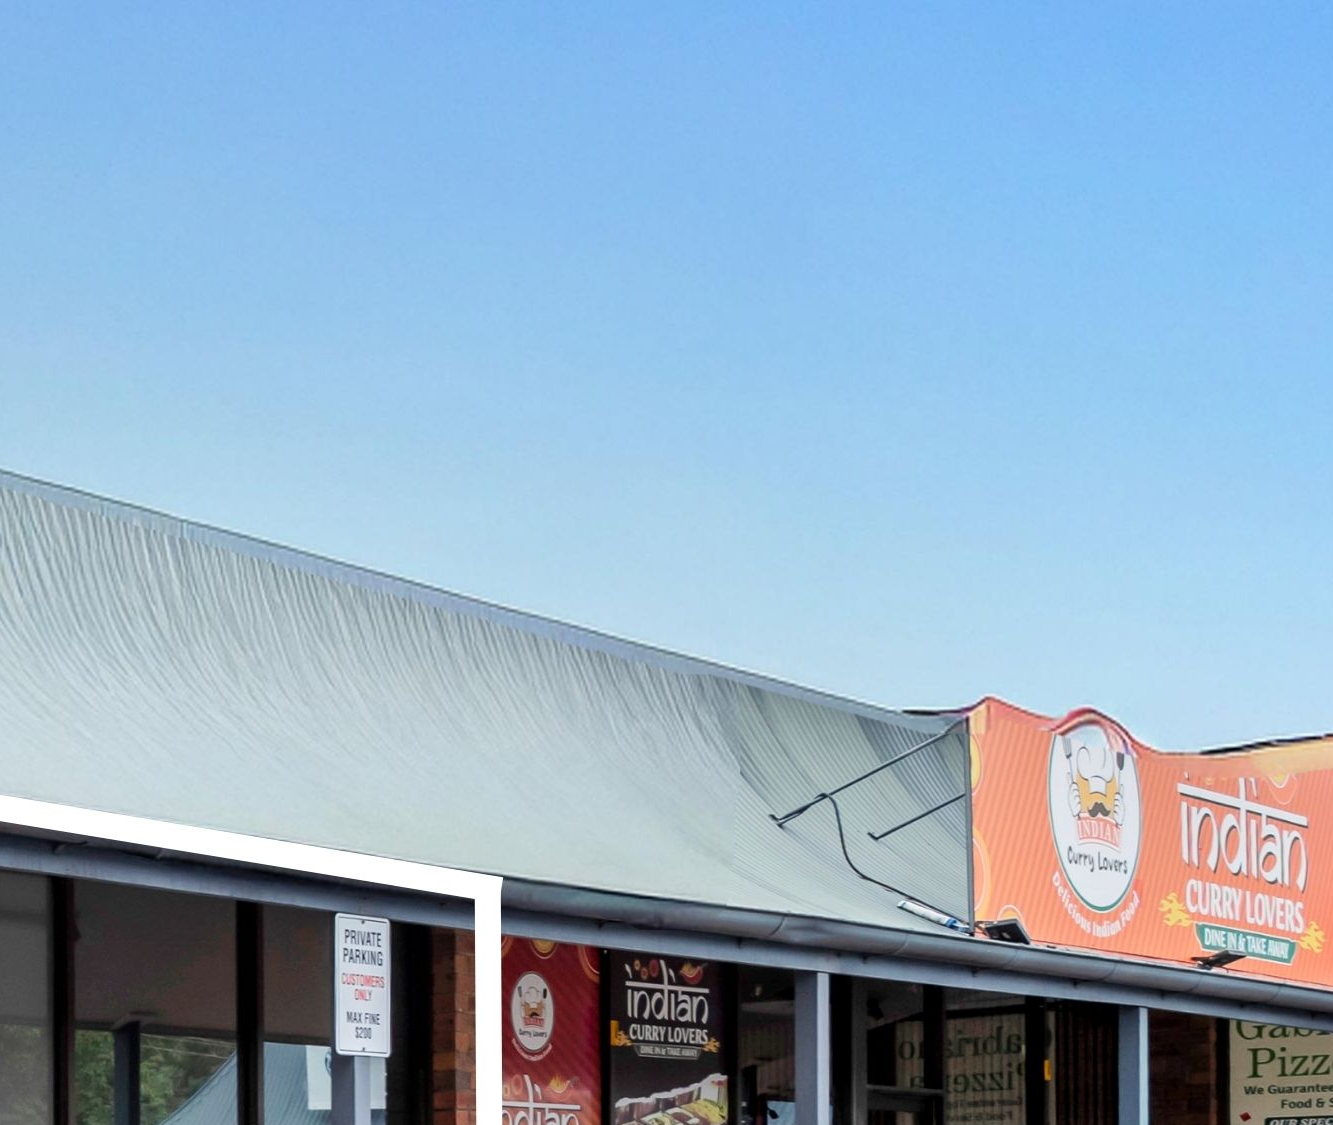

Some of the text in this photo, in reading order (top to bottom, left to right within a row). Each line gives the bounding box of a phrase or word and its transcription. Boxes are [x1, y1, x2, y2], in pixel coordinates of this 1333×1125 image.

[1077, 818, 1124, 848] INDIAN
[1177, 772, 1309, 893] indian
[1067, 846, 1128, 874] Curry Lovers
[1052, 872, 1091, 934] Delicious
[1092, 915, 1121, 937] Indian
[1186, 879, 1305, 934] CURRY LOVERS
[344, 929, 382, 948] PRIVATE
[1204, 927, 1226, 947] DINE
[1227, 930, 1238, 948] IN
[1246, 934, 1267, 955] TAKE
[1267, 939, 1290, 960] AWAY
[343, 947, 383, 966] PARKING
[341, 973, 385, 988] CUSTOMERS
[354, 988, 372, 1001] ONLY
[346, 1011, 380, 1026] MAX FINE
[355, 1026, 372, 1040] $200
[629, 1023, 708, 1044] CURRY LOVERS
[1247, 1047, 1333, 1078] Pizz
[1244, 1086, 1265, 1095] We
[1281, 1098, 1312, 1109] Food
[1316, 1098, 1325, 1108] &
